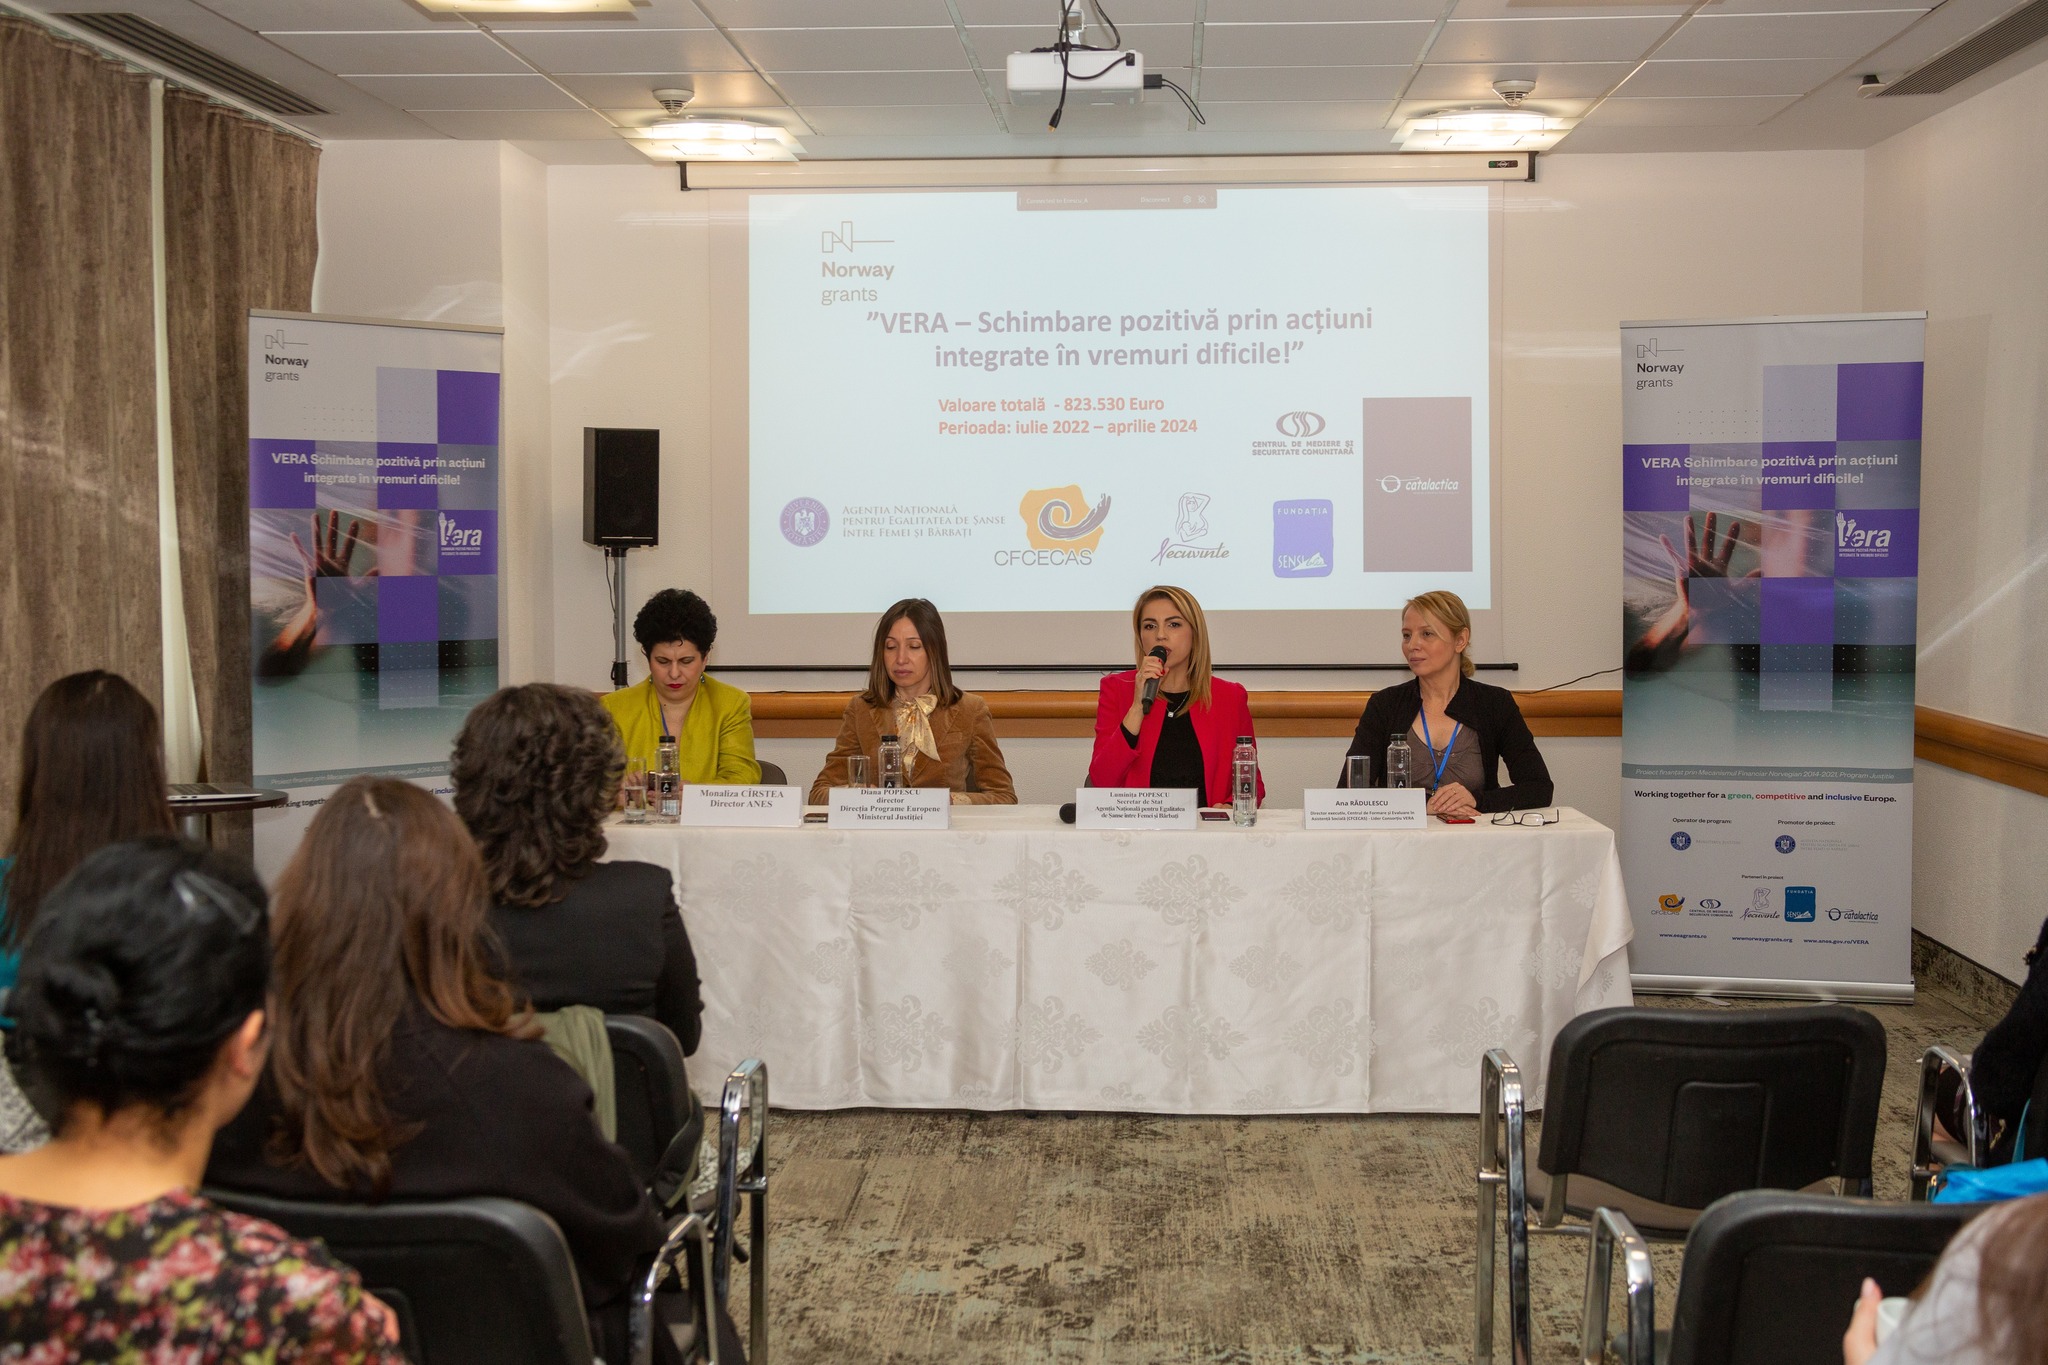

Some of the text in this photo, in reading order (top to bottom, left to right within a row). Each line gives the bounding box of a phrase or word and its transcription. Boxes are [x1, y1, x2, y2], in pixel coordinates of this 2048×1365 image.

[822, 261, 894, 280] Norway
[821, 287, 878, 306] grants
[978, 310, 1112, 333] Schimbare
[1120, 308, 1219, 337] pozitivă
[1228, 308, 1278, 336] prin
[1286, 307, 1372, 335] acțiuni
[265, 354, 309, 368] Norway
[935, 346, 1049, 372] integrate
[1056, 343, 1080, 366] în
[1088, 343, 1188, 365] vremuri
[1637, 363, 1684, 374] Norway
[264, 370, 300, 382] grants
[1636, 377, 1674, 390] grants
[938, 397, 1164, 412] Valoare totală 823.530 Euro
[939, 419, 1198, 436] Perioada: iulie 2022 aprilie 2024
[1306, 440, 1341, 448] MEDIERE
[1302, 447, 1354, 456] COMUNITARĂ
[272, 453, 486, 471] VERA Schimbare pozitivă prin acțiuni
[1641, 454, 1898, 470] VERA Schimbare pozitivă prin acțiuni
[304, 472, 357, 486] integrate
[372, 474, 417, 485] vremuri
[419, 474, 460, 485] dificile!
[1406, 478, 1459, 491] catalactica
[1676, 473, 1864, 488] integrate în vremuri dificile!
[994, 549, 1092, 566] CFCECAS
[1685, 769, 1698, 777] prin
[1840, 772, 1869, 780] Program
[700, 788, 784, 798] Monaliza CÎRSTEA
[1634, 790, 1669, 799] Working
[1670, 791, 1706, 800] together
[1755, 793, 1806, 801] competitive
[1864, 794, 1897, 804] Europe.
[746, 800, 773, 808] ANES
[840, 805, 868, 813] Direcția
[1844, 911, 1878, 921] catalactica
